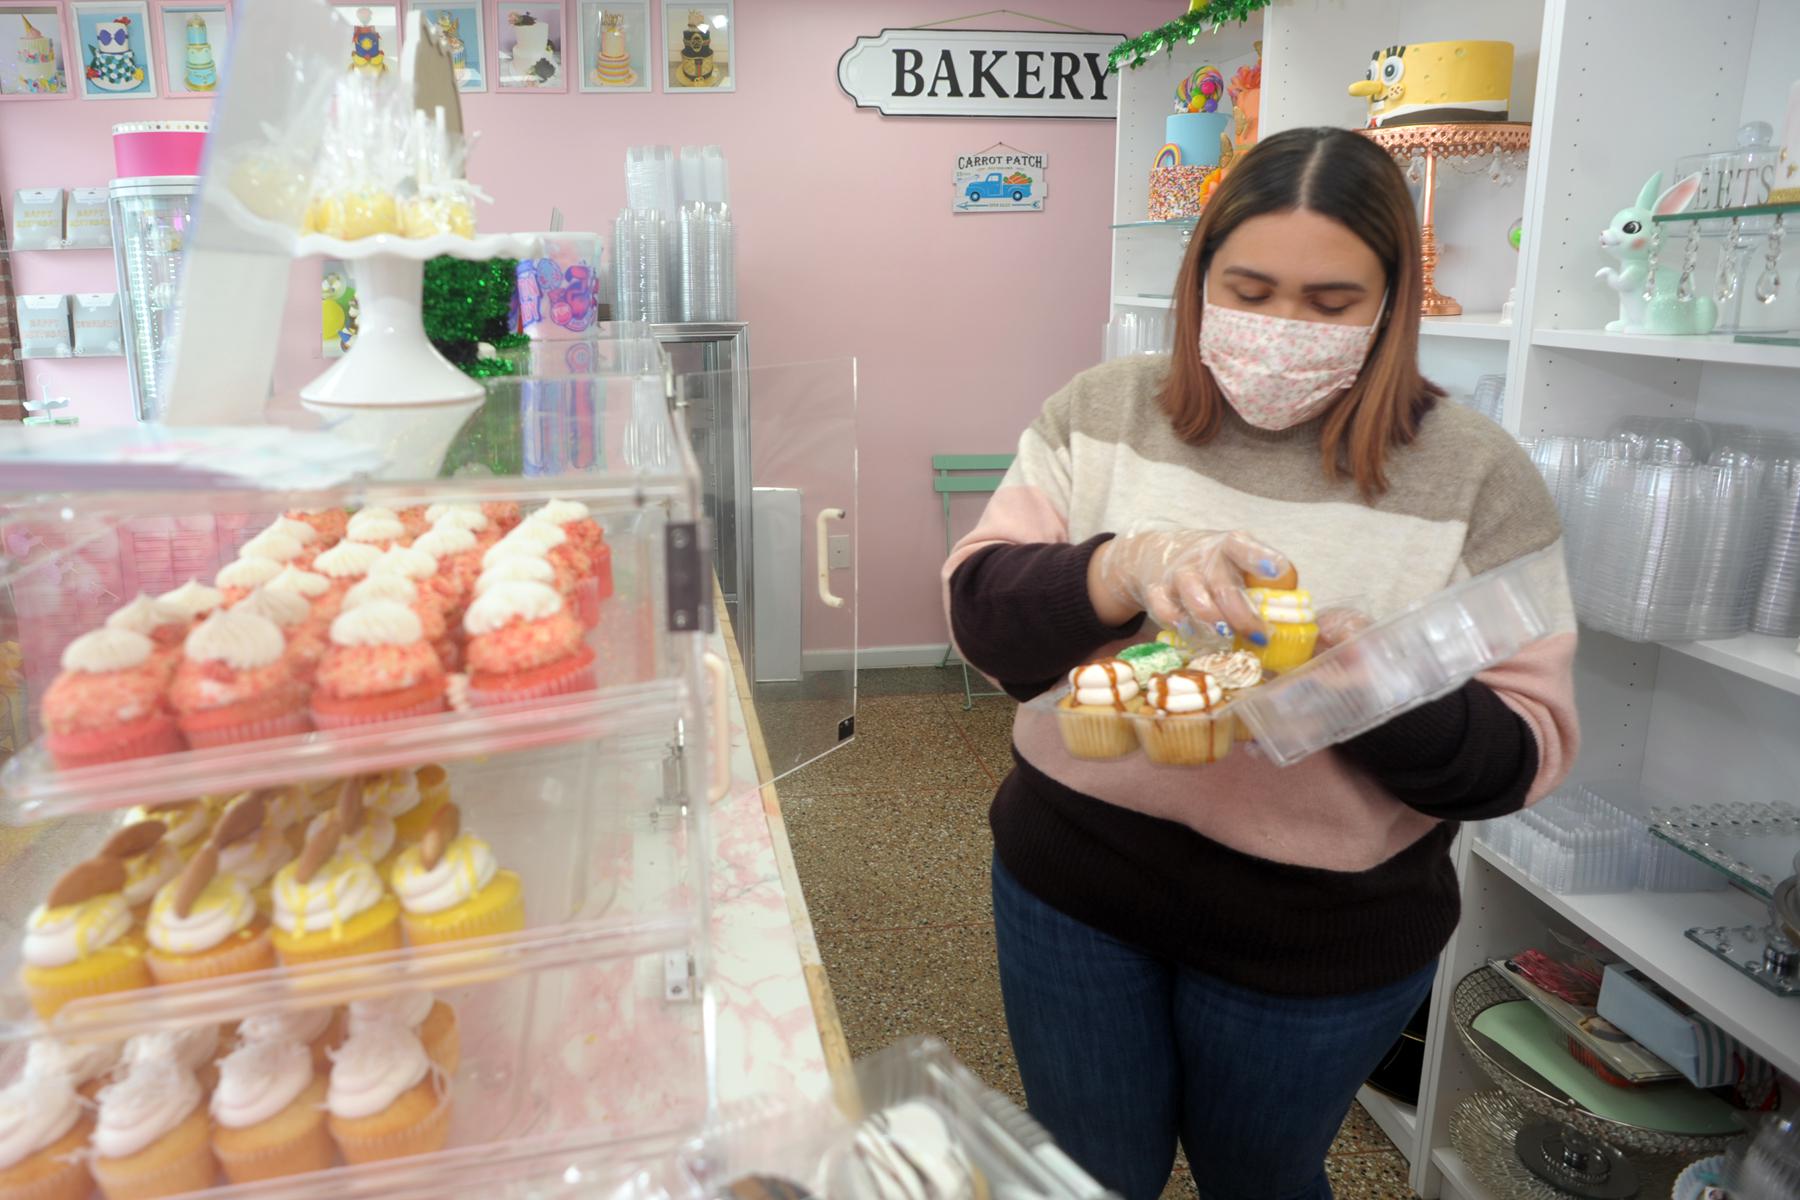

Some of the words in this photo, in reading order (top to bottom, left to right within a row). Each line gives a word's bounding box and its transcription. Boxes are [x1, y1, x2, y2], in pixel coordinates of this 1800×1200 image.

[891, 48, 1110, 100] BAKERY
[958, 156, 1002, 170] CARROT
[1006, 156, 1042, 168] PATCH
[1673, 164, 1774, 210] EETS
